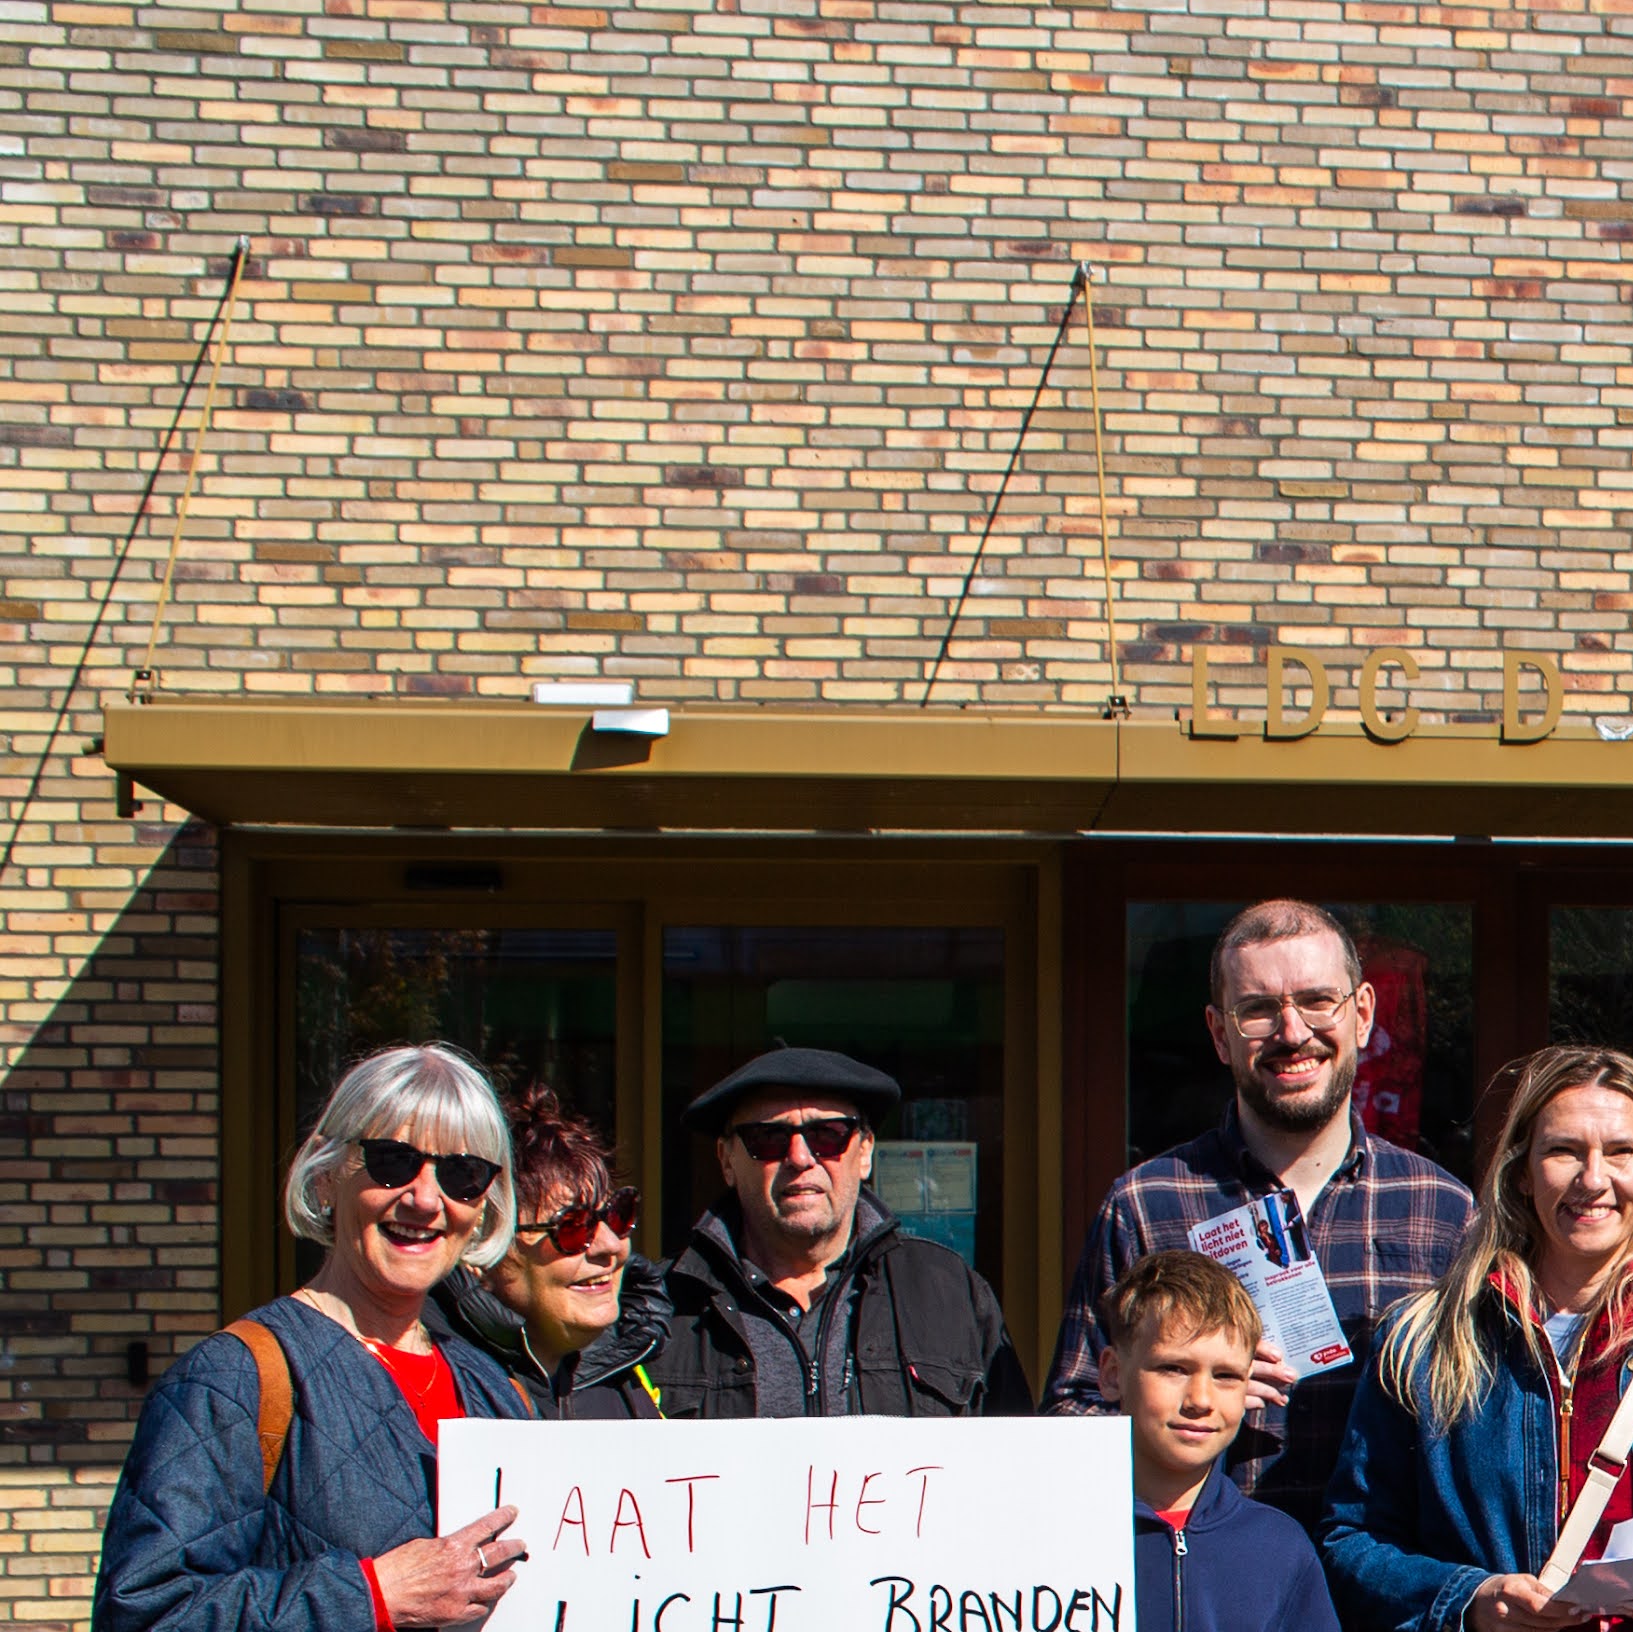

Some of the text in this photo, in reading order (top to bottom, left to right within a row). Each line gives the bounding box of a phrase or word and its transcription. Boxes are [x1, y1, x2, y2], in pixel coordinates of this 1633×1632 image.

[1193, 646, 1421, 741] LDC
[1199, 1219, 1240, 1241] Laat het
[1201, 1228, 1245, 1252] licht niet
[1209, 1240, 1249, 1260] itdoven
[804, 1464, 944, 1546] HET
